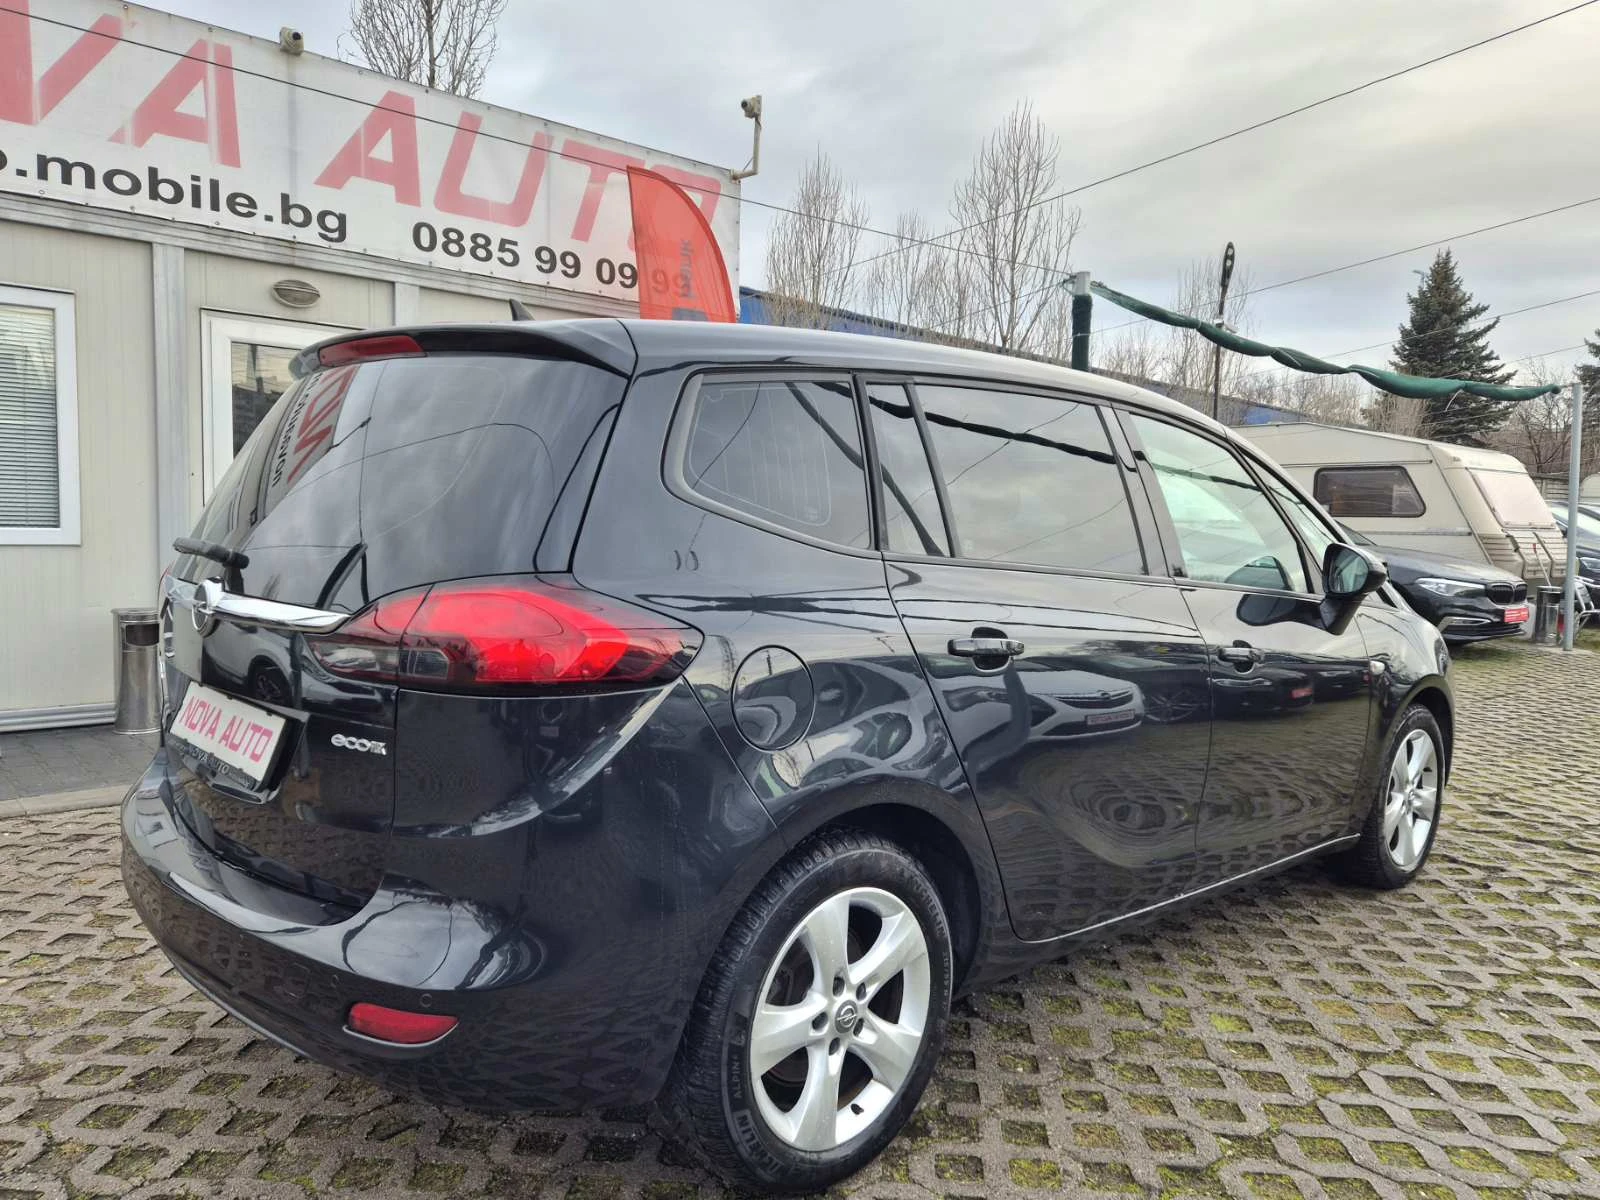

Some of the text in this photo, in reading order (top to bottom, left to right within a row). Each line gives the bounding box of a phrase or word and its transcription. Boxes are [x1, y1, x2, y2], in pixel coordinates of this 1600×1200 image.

[0, 152, 347, 243] .mobile.bg
[412, 221, 520, 267] 0885
[534, 246, 581, 279] 99
[595, 257, 638, 289] 09
[179, 695, 222, 741] NOVA
[219, 715, 274, 763] AUTO
